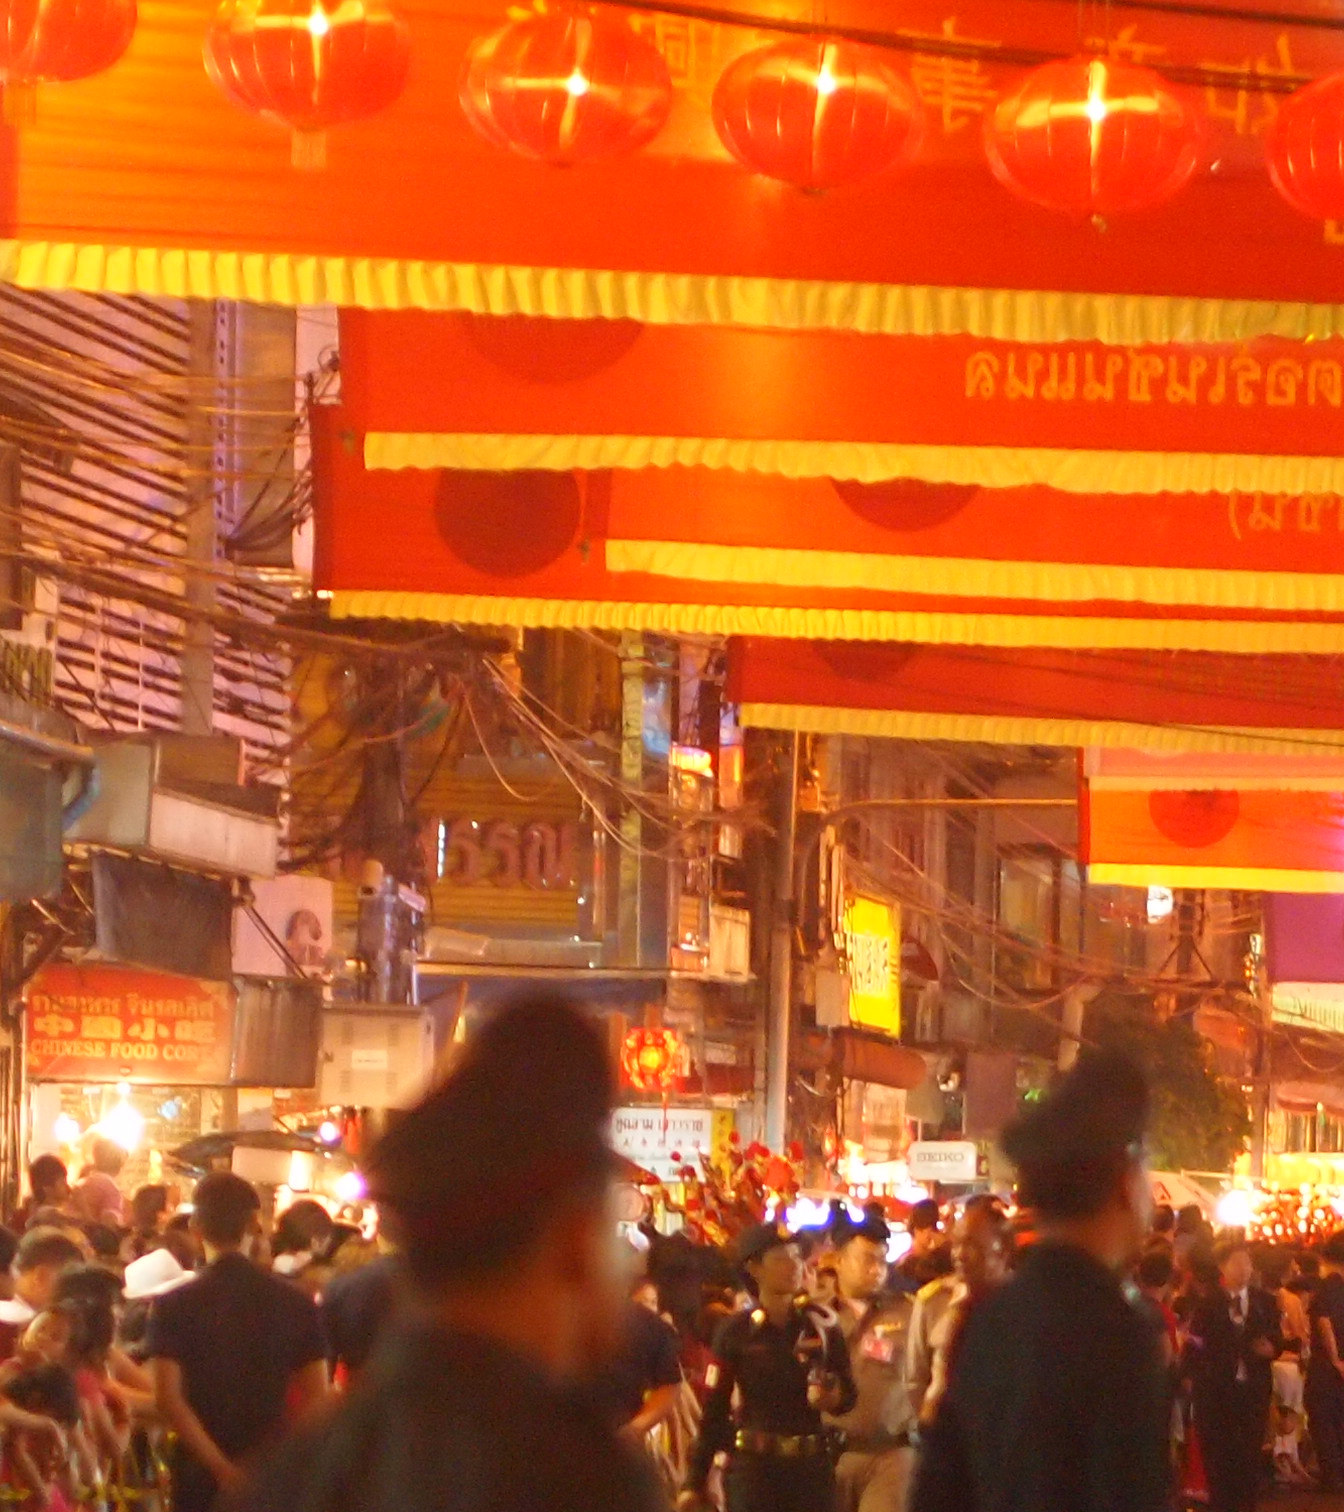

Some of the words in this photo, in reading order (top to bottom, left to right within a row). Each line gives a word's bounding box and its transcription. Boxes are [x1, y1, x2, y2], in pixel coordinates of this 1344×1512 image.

[31, 1039, 105, 1057] CHINESE
[110, 1042, 158, 1059] FOOD
[917, 1151, 965, 1163] SEIKO
